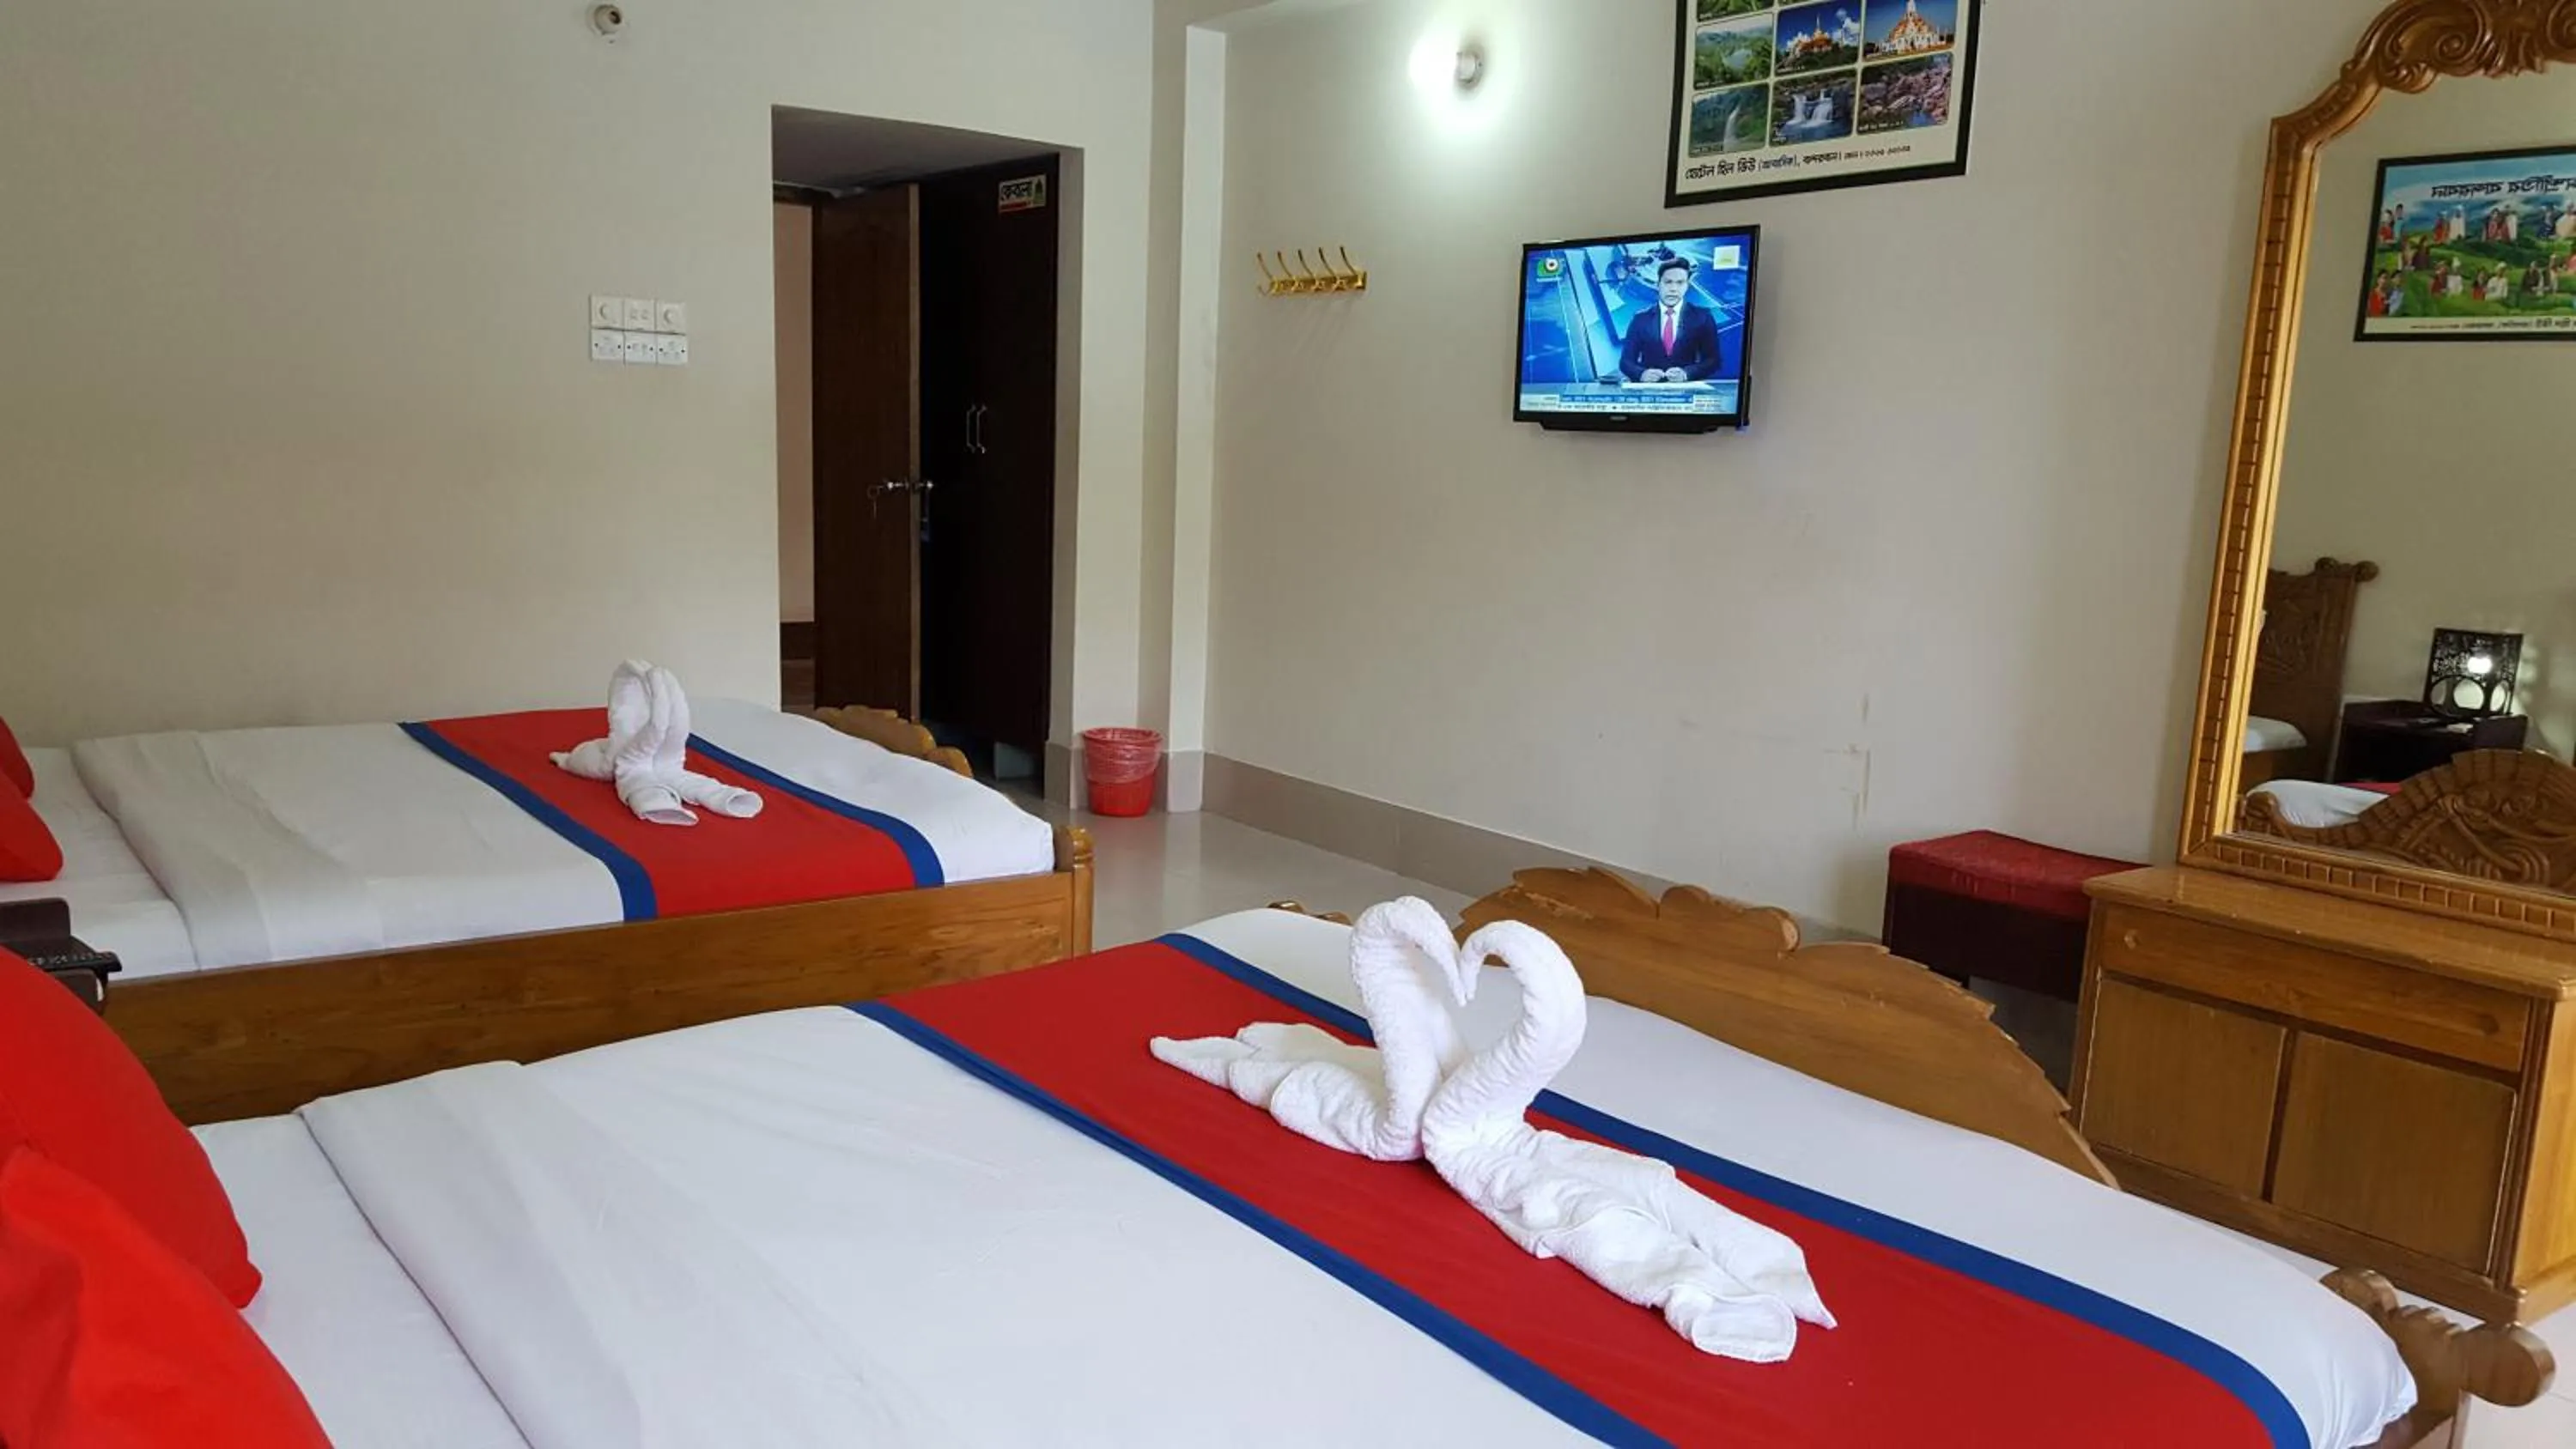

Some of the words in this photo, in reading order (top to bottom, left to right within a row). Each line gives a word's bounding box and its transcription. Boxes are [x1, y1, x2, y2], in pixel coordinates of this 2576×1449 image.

[1686, 164, 1715, 179] হোটেল
[1717, 158, 1735, 175] হিল
[1738, 157, 1756, 173] ভিউ
